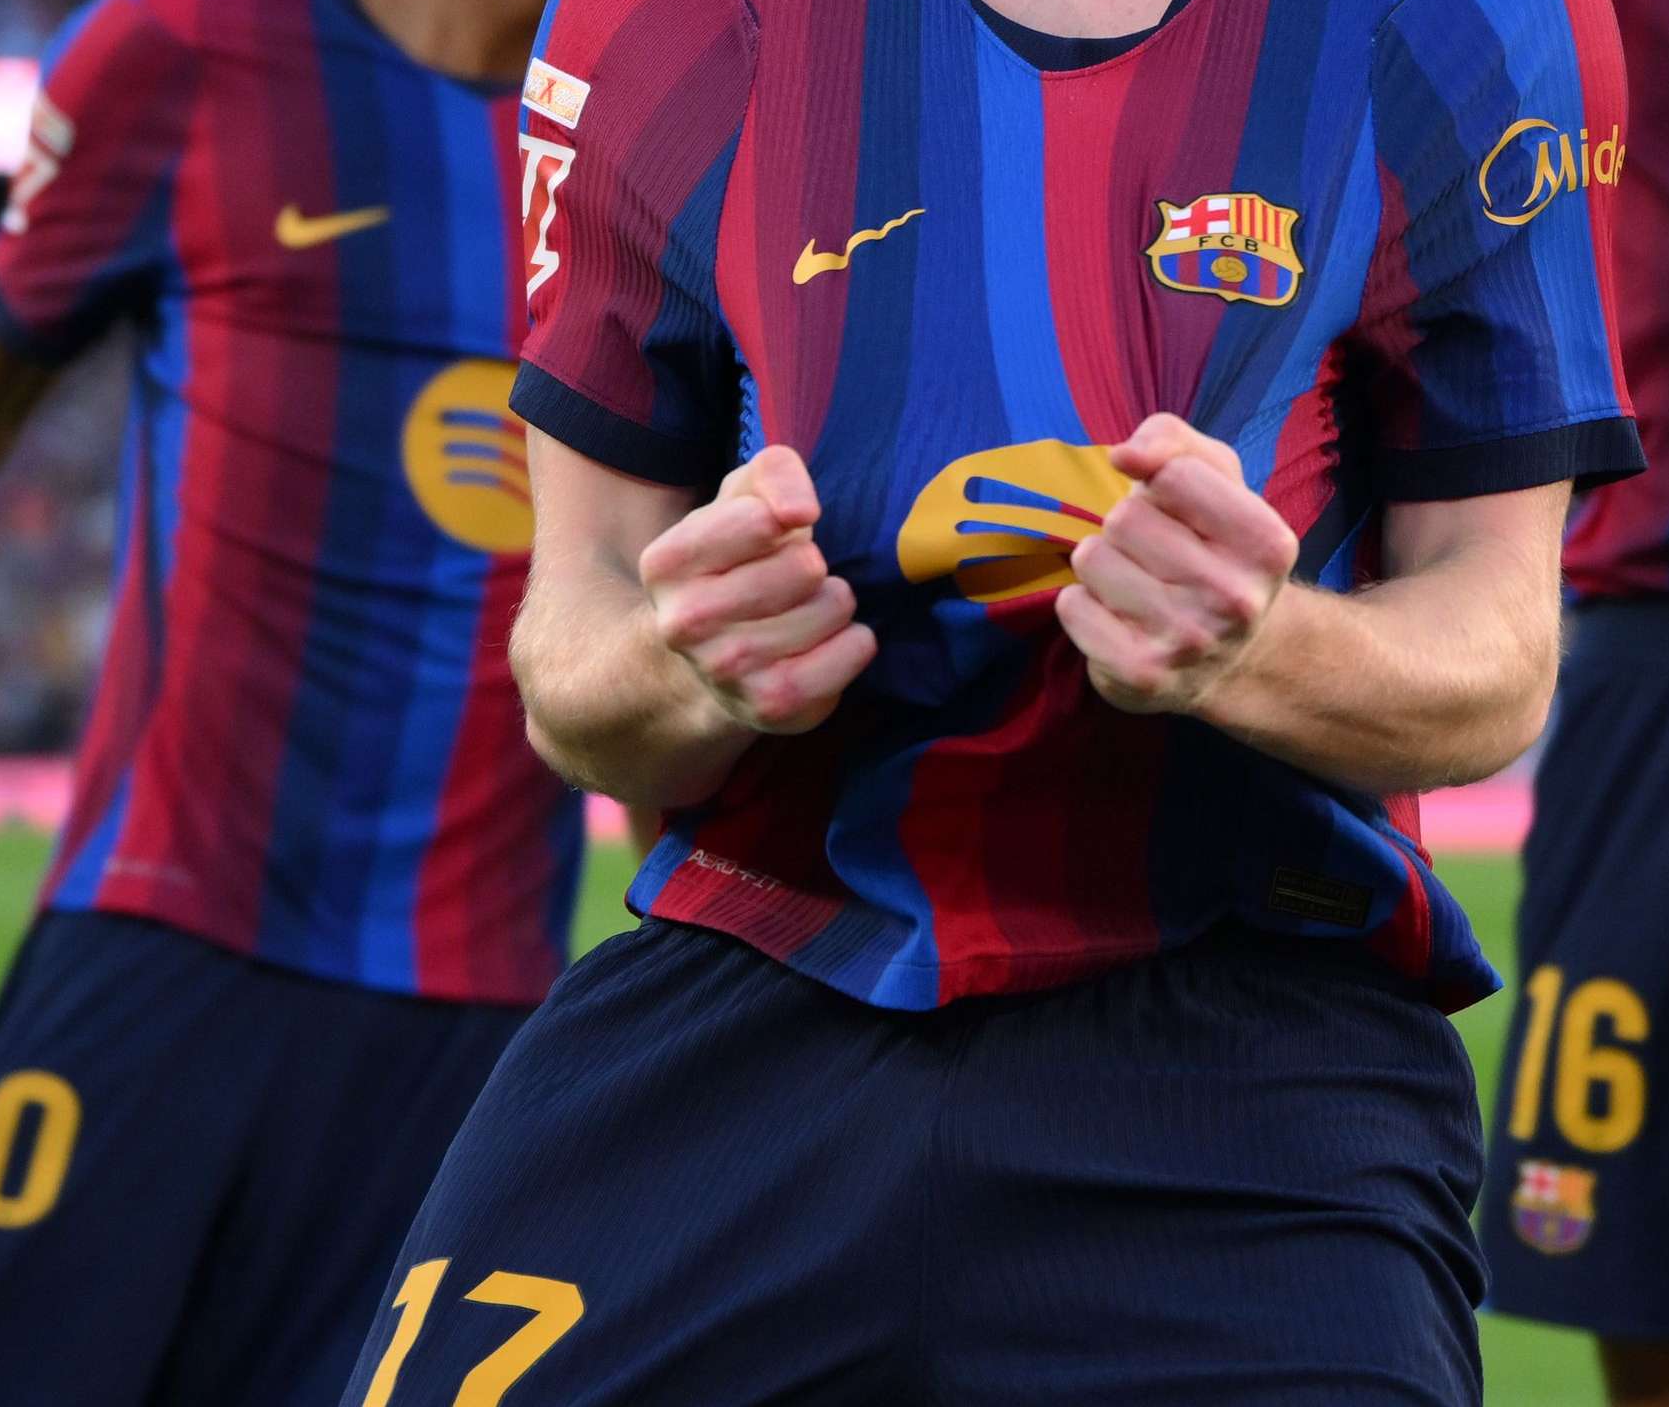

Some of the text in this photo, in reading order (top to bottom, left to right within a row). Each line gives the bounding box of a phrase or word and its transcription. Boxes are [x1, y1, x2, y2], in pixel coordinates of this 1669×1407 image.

[1198, 234, 1259, 252] FCB
[1509, 963, 1651, 1153] 16
[362, 1257, 587, 1407] 17
